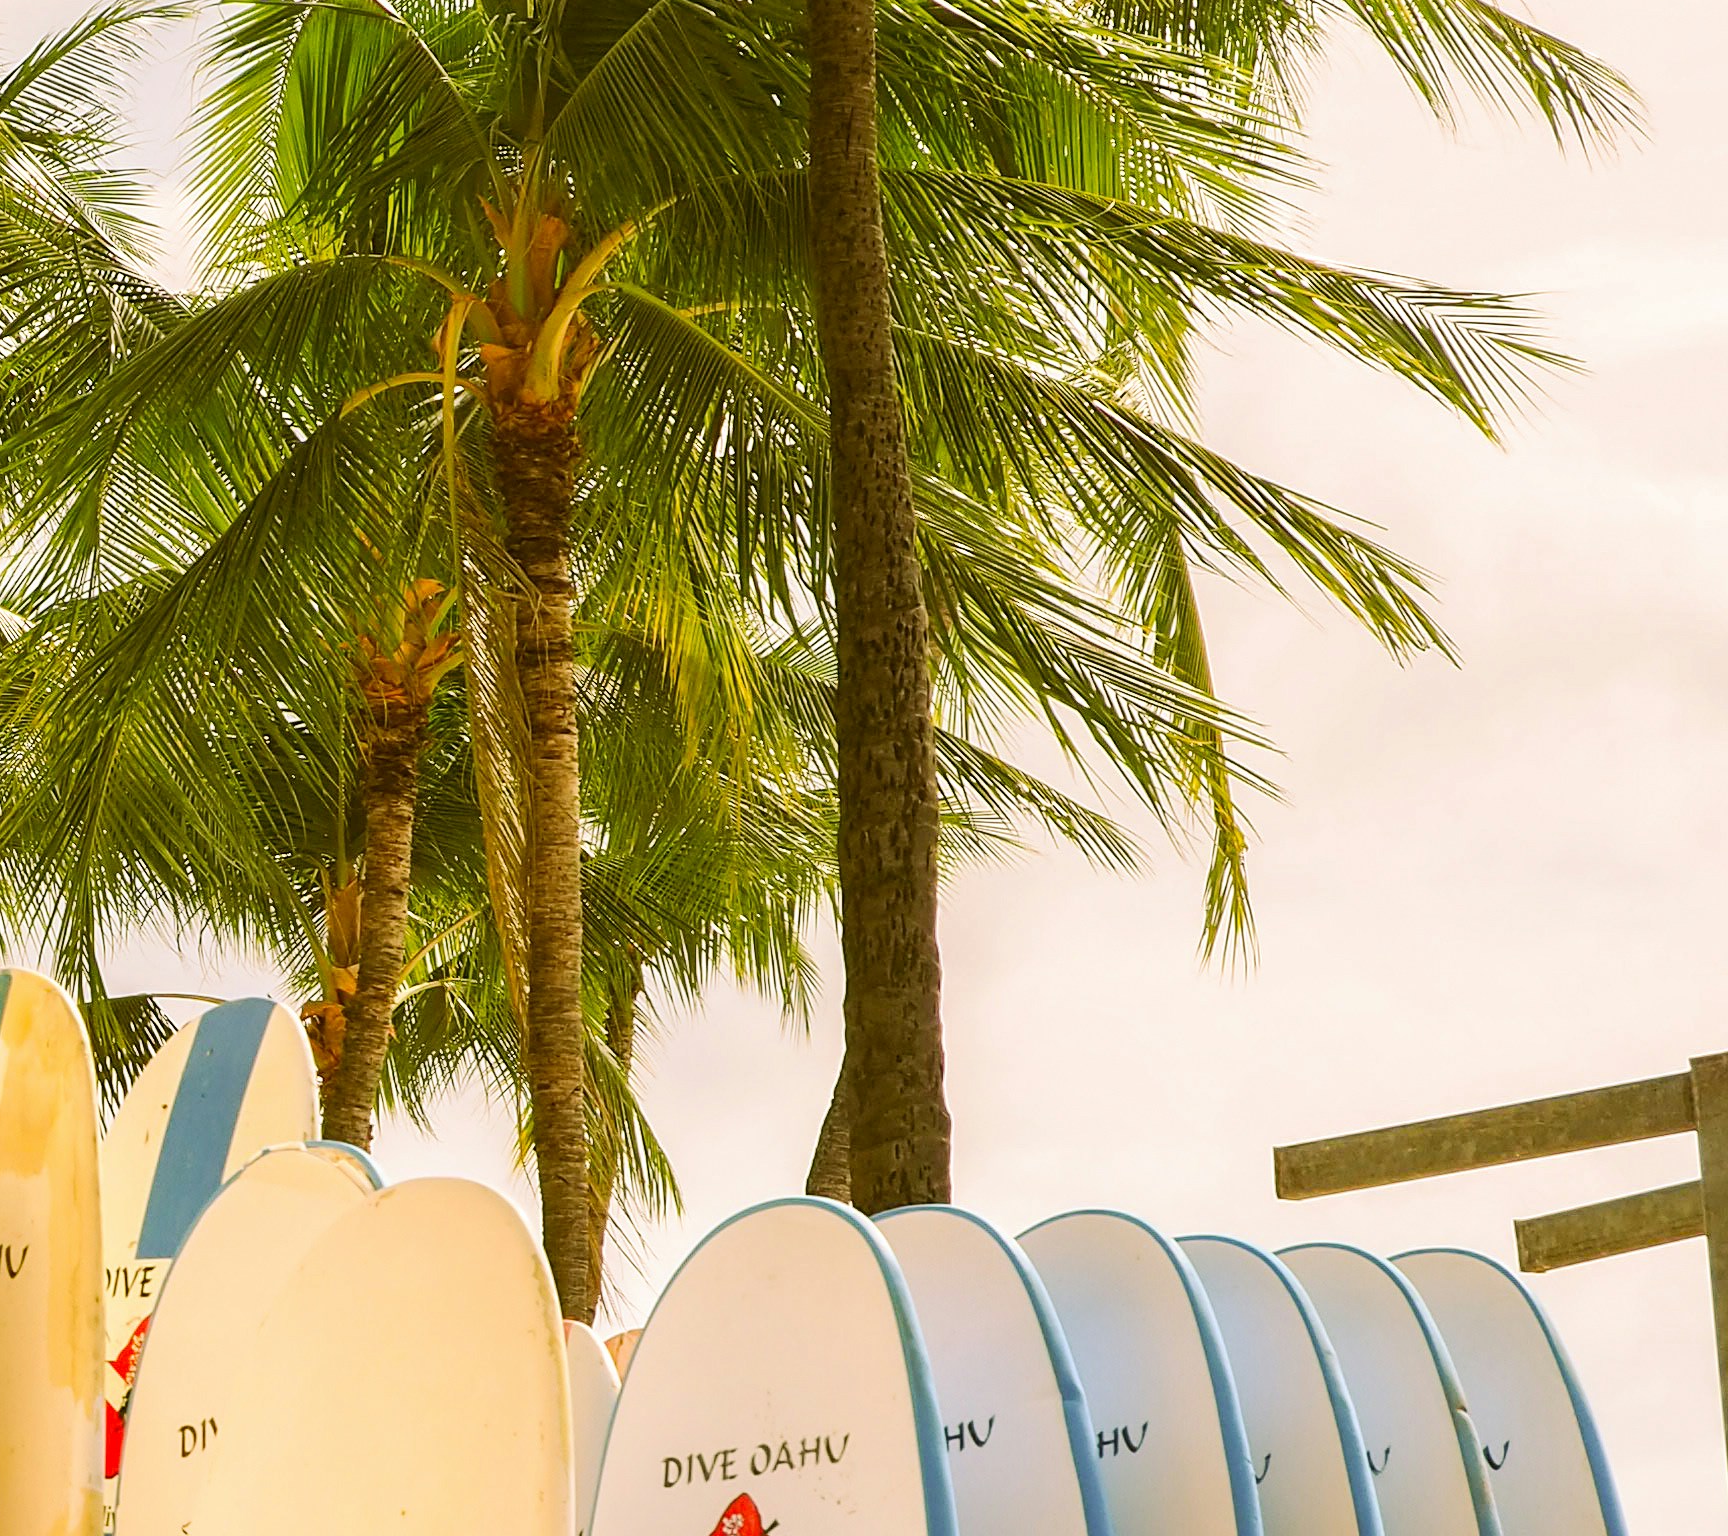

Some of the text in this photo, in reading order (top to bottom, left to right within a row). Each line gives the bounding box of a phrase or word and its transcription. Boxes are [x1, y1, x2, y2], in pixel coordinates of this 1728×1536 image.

[944, 1415, 995, 1452] HU
[1097, 1421, 1148, 1458] HU
[662, 1434, 850, 1489] DIVE OAHU
